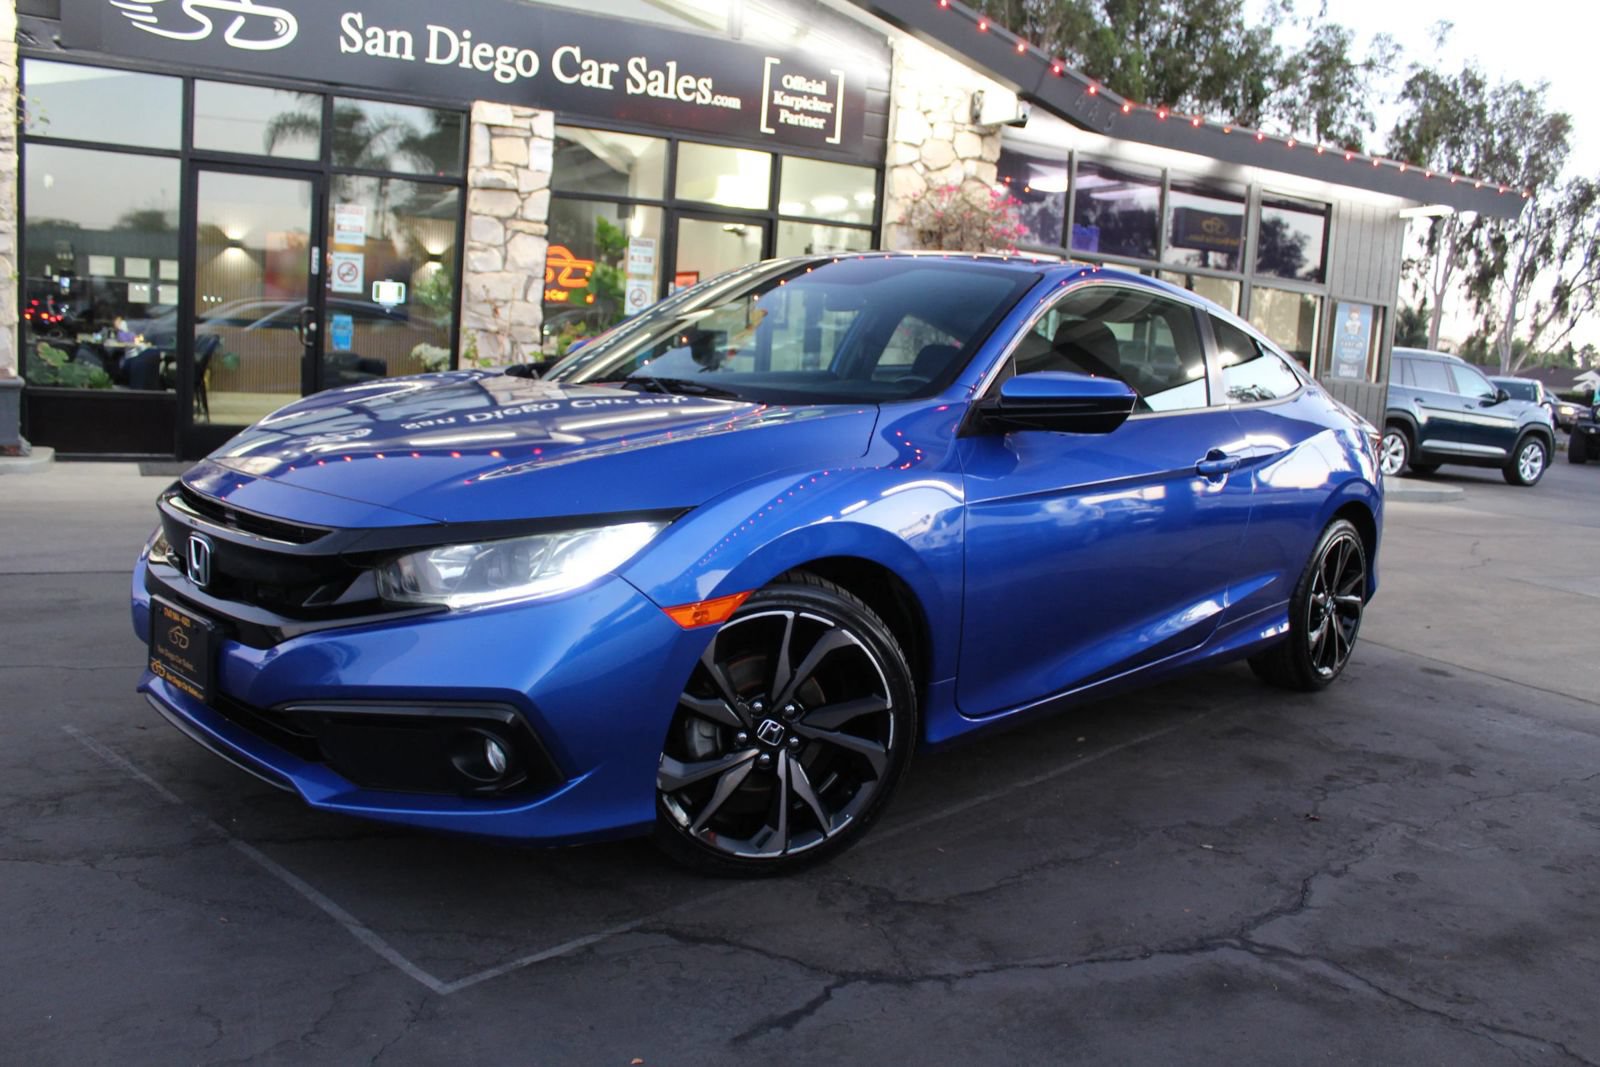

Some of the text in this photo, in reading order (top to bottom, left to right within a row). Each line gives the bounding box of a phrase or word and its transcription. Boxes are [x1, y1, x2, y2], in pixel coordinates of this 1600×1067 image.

[340, 12, 741, 110] San Diego Car Sales.com
[782, 74, 828, 96] Official
[779, 108, 827, 130] Partner
